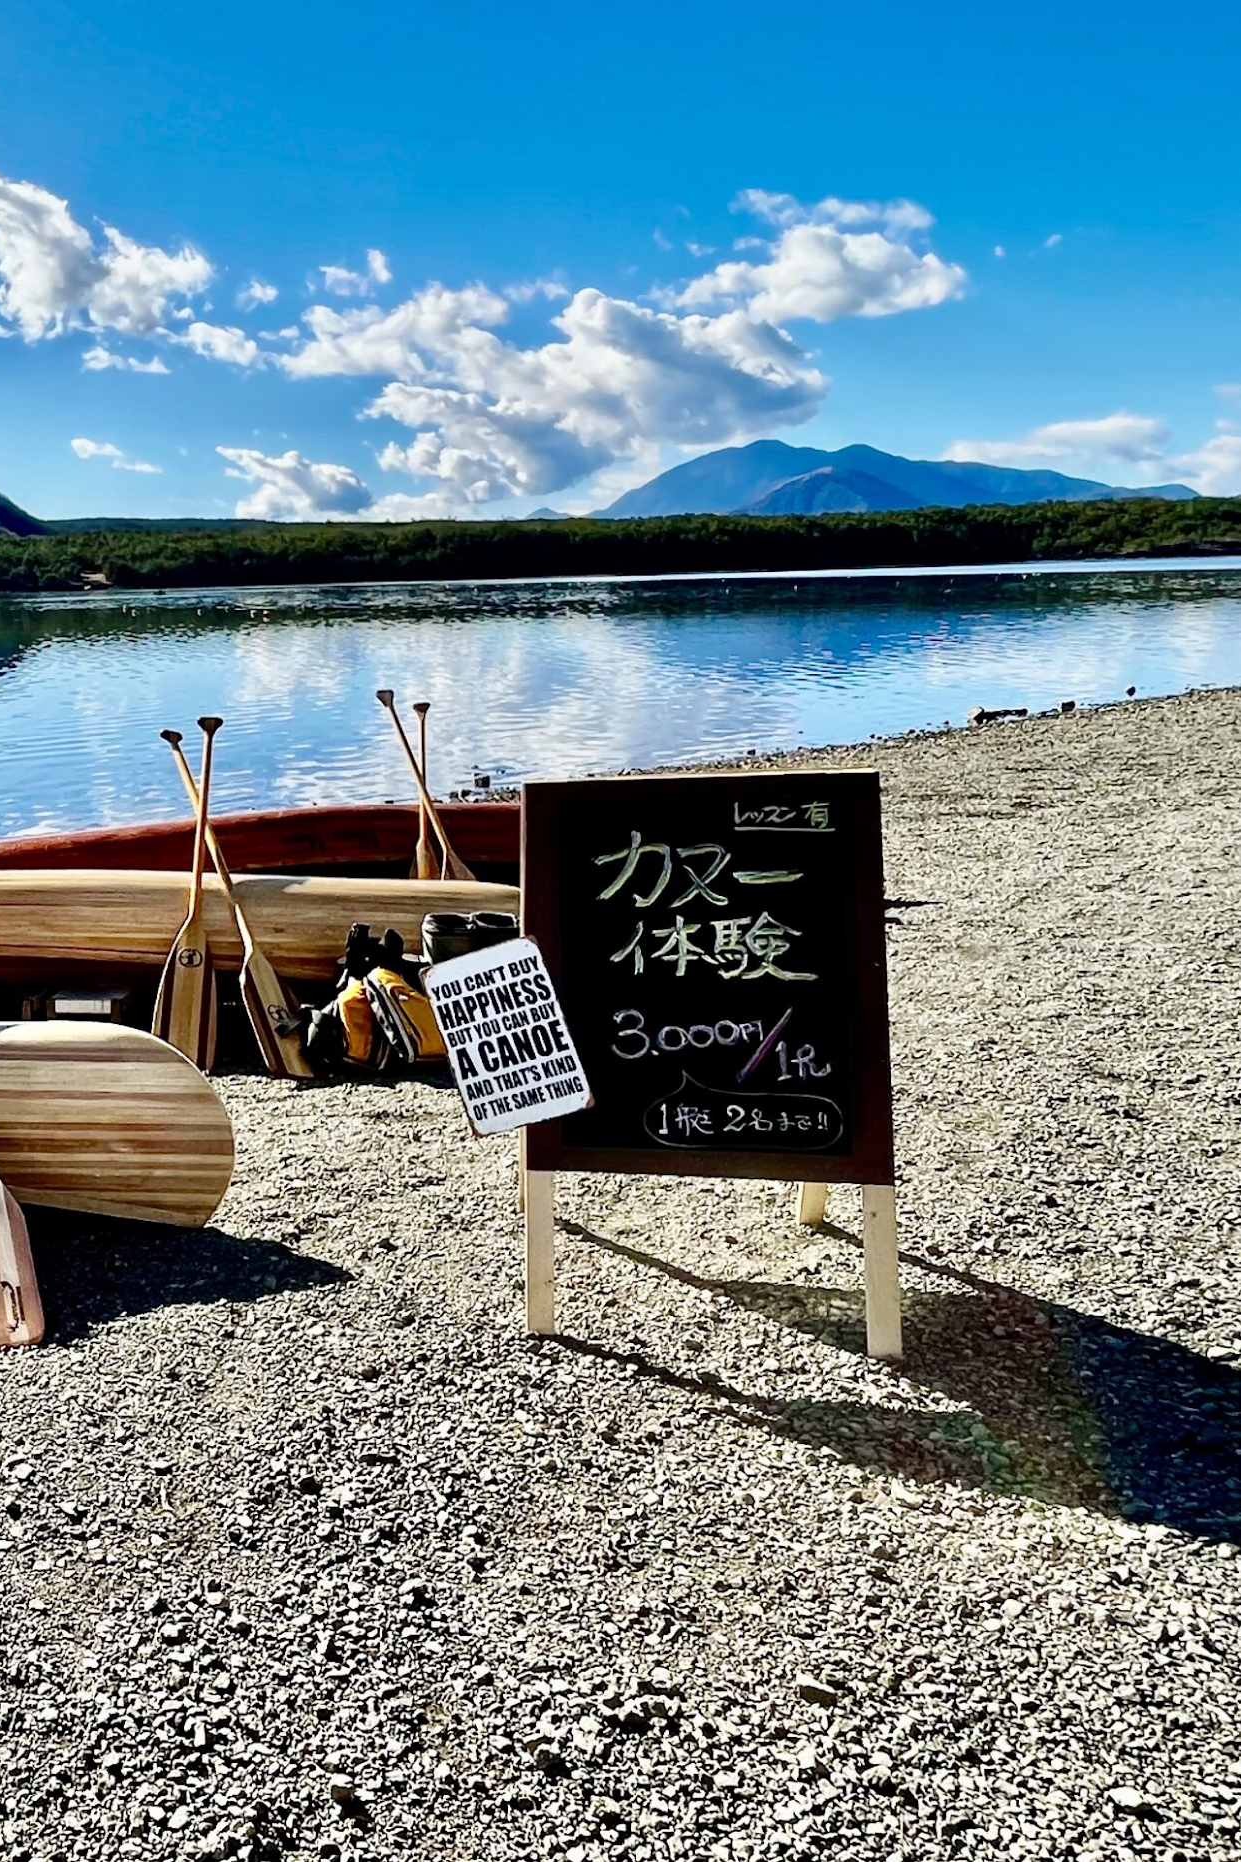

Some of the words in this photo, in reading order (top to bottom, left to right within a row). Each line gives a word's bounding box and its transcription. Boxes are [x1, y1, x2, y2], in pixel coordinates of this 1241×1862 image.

[592, 831, 804, 908] カヌー
[610, 911, 819, 981] 体験
[431, 980, 462, 1001] YOU
[464, 966, 507, 992] CAN'T
[508, 955, 540, 978] BUY
[436, 974, 552, 1031] HAPPINESS
[447, 1027, 474, 1047] BUT
[473, 1018, 501, 1039] YOU
[501, 1010, 529, 1031] CAN
[529, 1002, 558, 1022] BUY
[456, 1047, 479, 1080] A
[477, 1019, 570, 1073] CANOE
[466, 1079, 494, 1101] AND
[494, 1065, 541, 1092] THAT'S
[542, 1055, 577, 1078] KIND
[473, 1104, 488, 1121] OF
[488, 1096, 513, 1117] THE
[513, 1087, 546, 1110] SAME
[543, 1076, 584, 1101] THING
